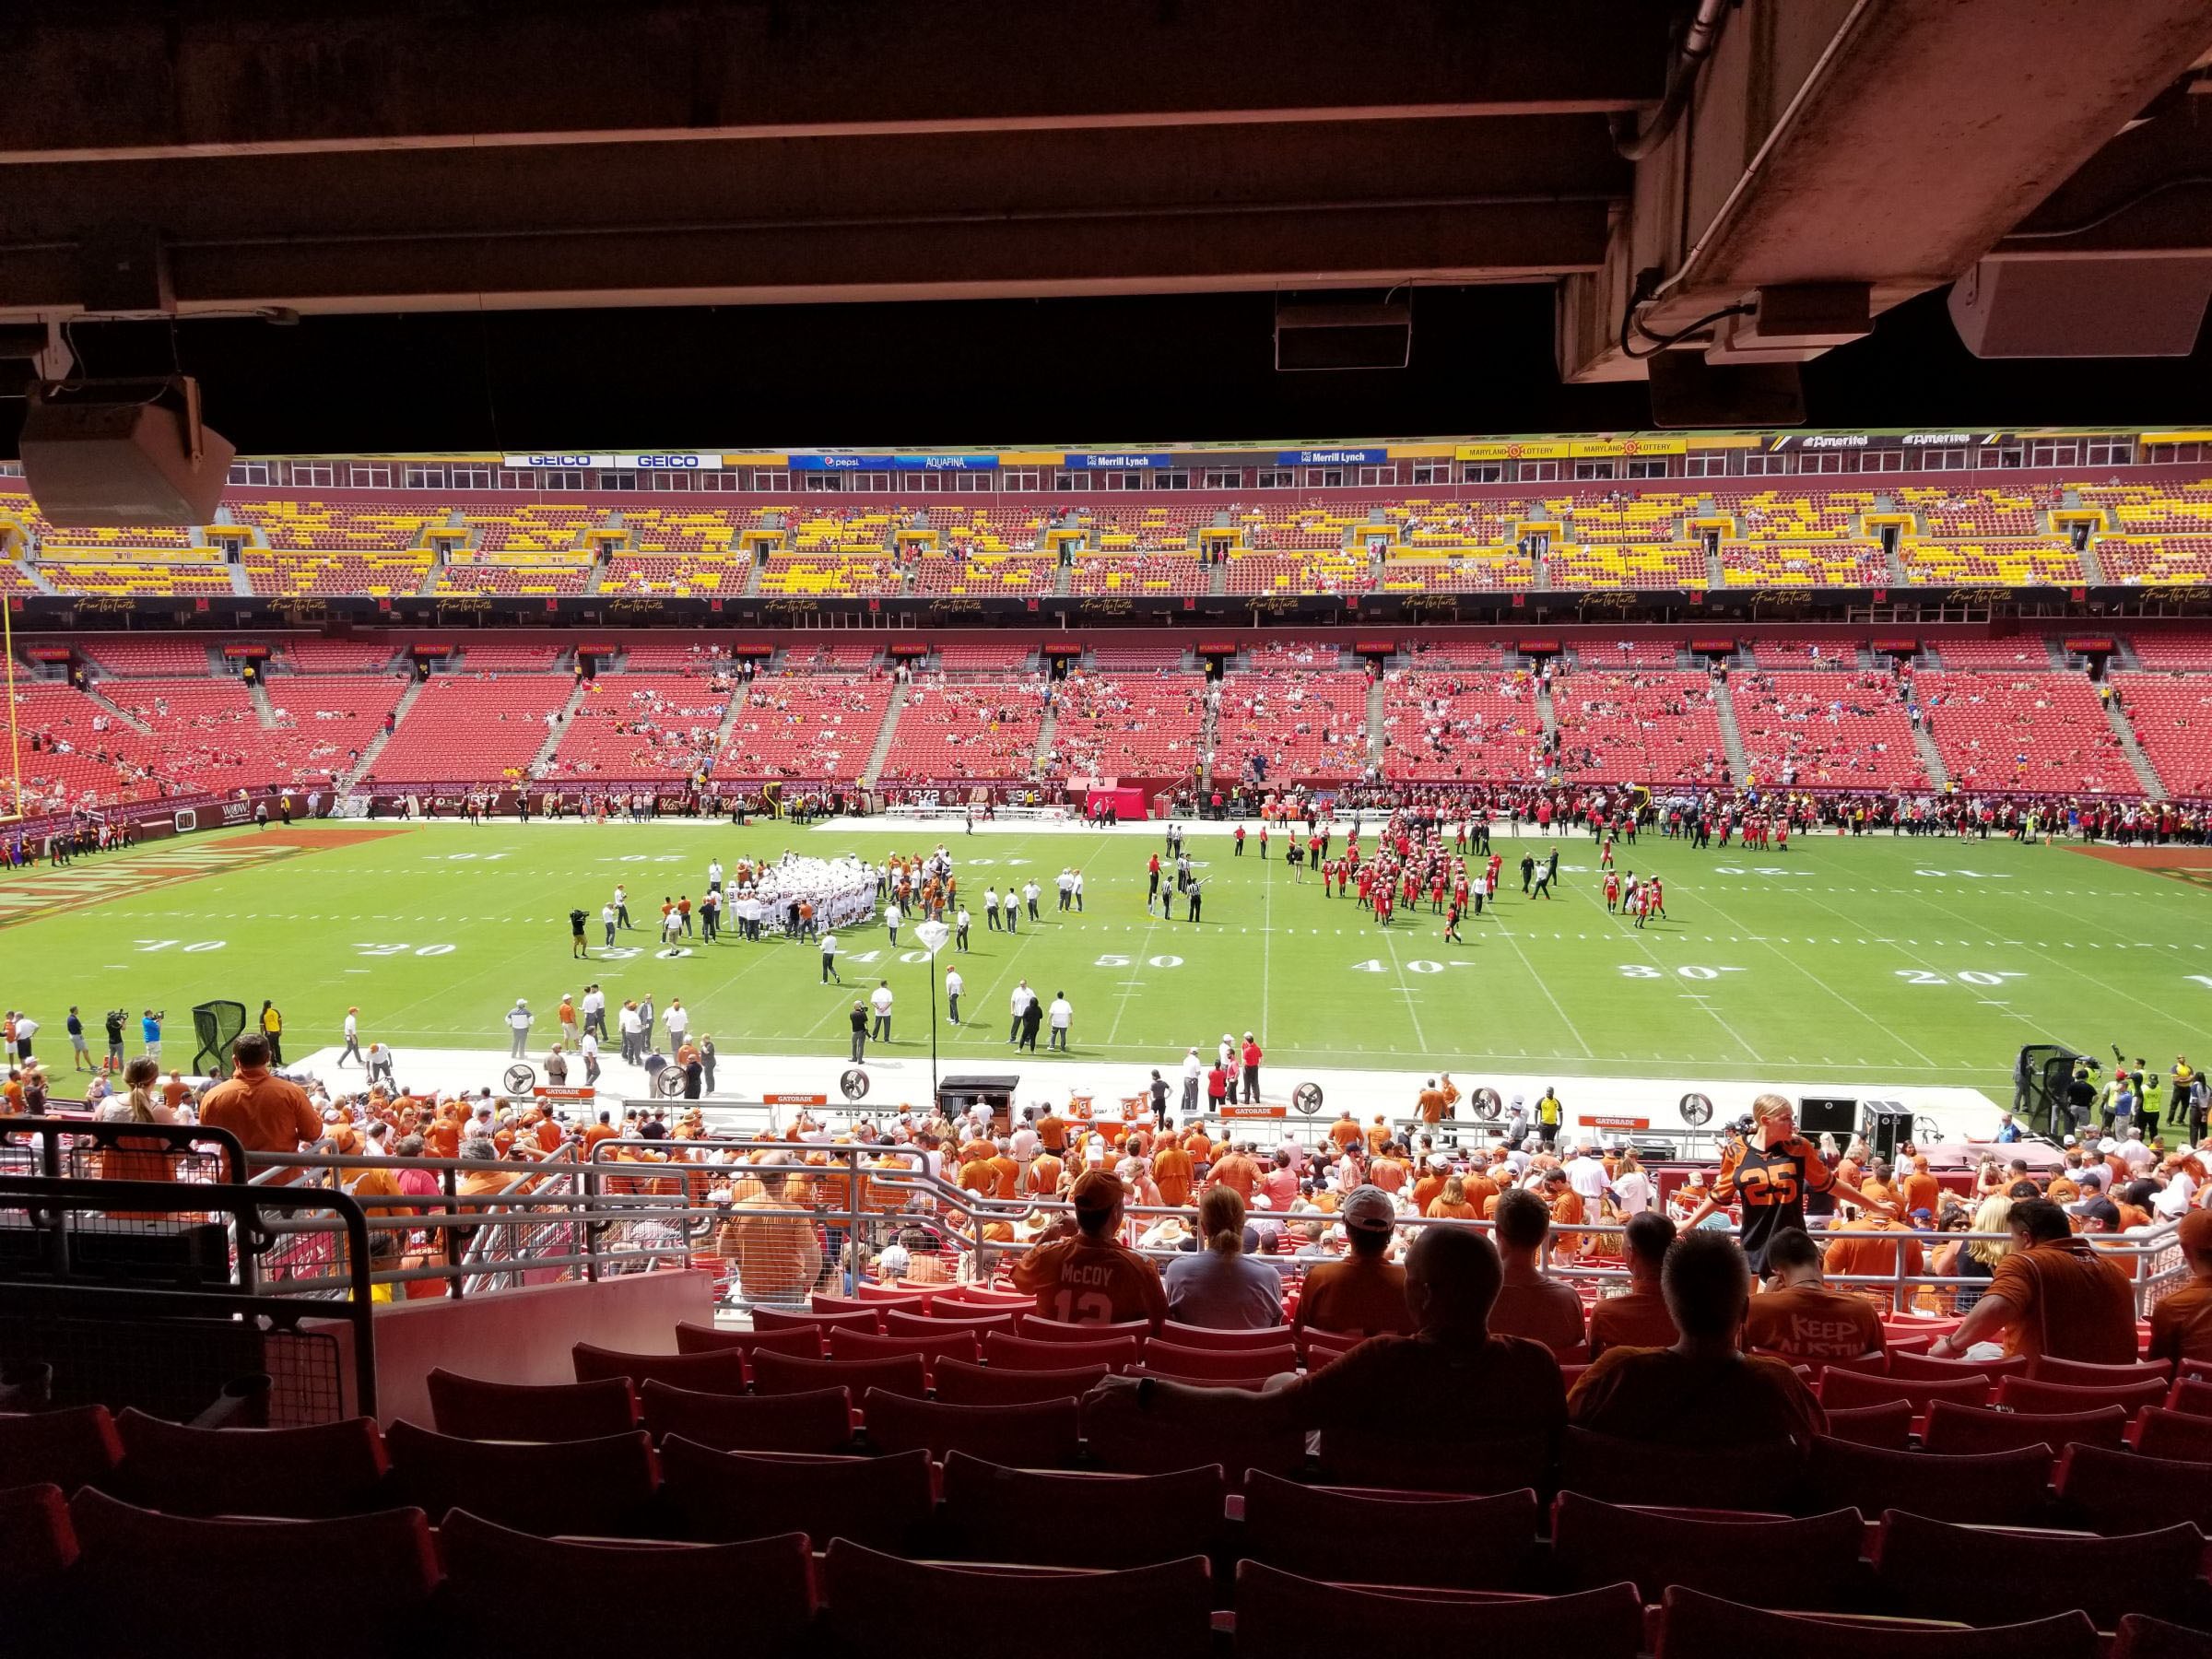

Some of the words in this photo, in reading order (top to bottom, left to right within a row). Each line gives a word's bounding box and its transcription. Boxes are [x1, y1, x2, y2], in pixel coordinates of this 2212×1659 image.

[1312, 453, 1339, 462] Merrill
[1341, 453, 1365, 463] Lynch
[1469, 448, 1507, 456] MARYLAND
[528, 455, 591, 467] GEICO
[637, 455, 699, 467] GEICO
[835, 458, 859, 467] pepsi
[925, 456, 967, 468] AQUAFINA
[1098, 457, 1124, 465] Merrill
[1125, 456, 1148, 466] Lynch
[222, 799, 251, 816] WOW!
[179, 814, 193, 827] 40
[133, 939, 227, 952] 10
[356, 943, 457, 957] 20
[845, 950, 934, 963] 40
[1094, 955, 1184, 968] 50
[1351, 959, 1444, 972] 40
[1618, 965, 1719, 980] 30
[1895, 970, 2004, 984] 20
[1740, 1163, 1797, 1206] 25
[1061, 1264, 1113, 1287] McCOY
[1054, 1289, 1113, 1325] 12
[1791, 1313, 1859, 1342] KEEP
